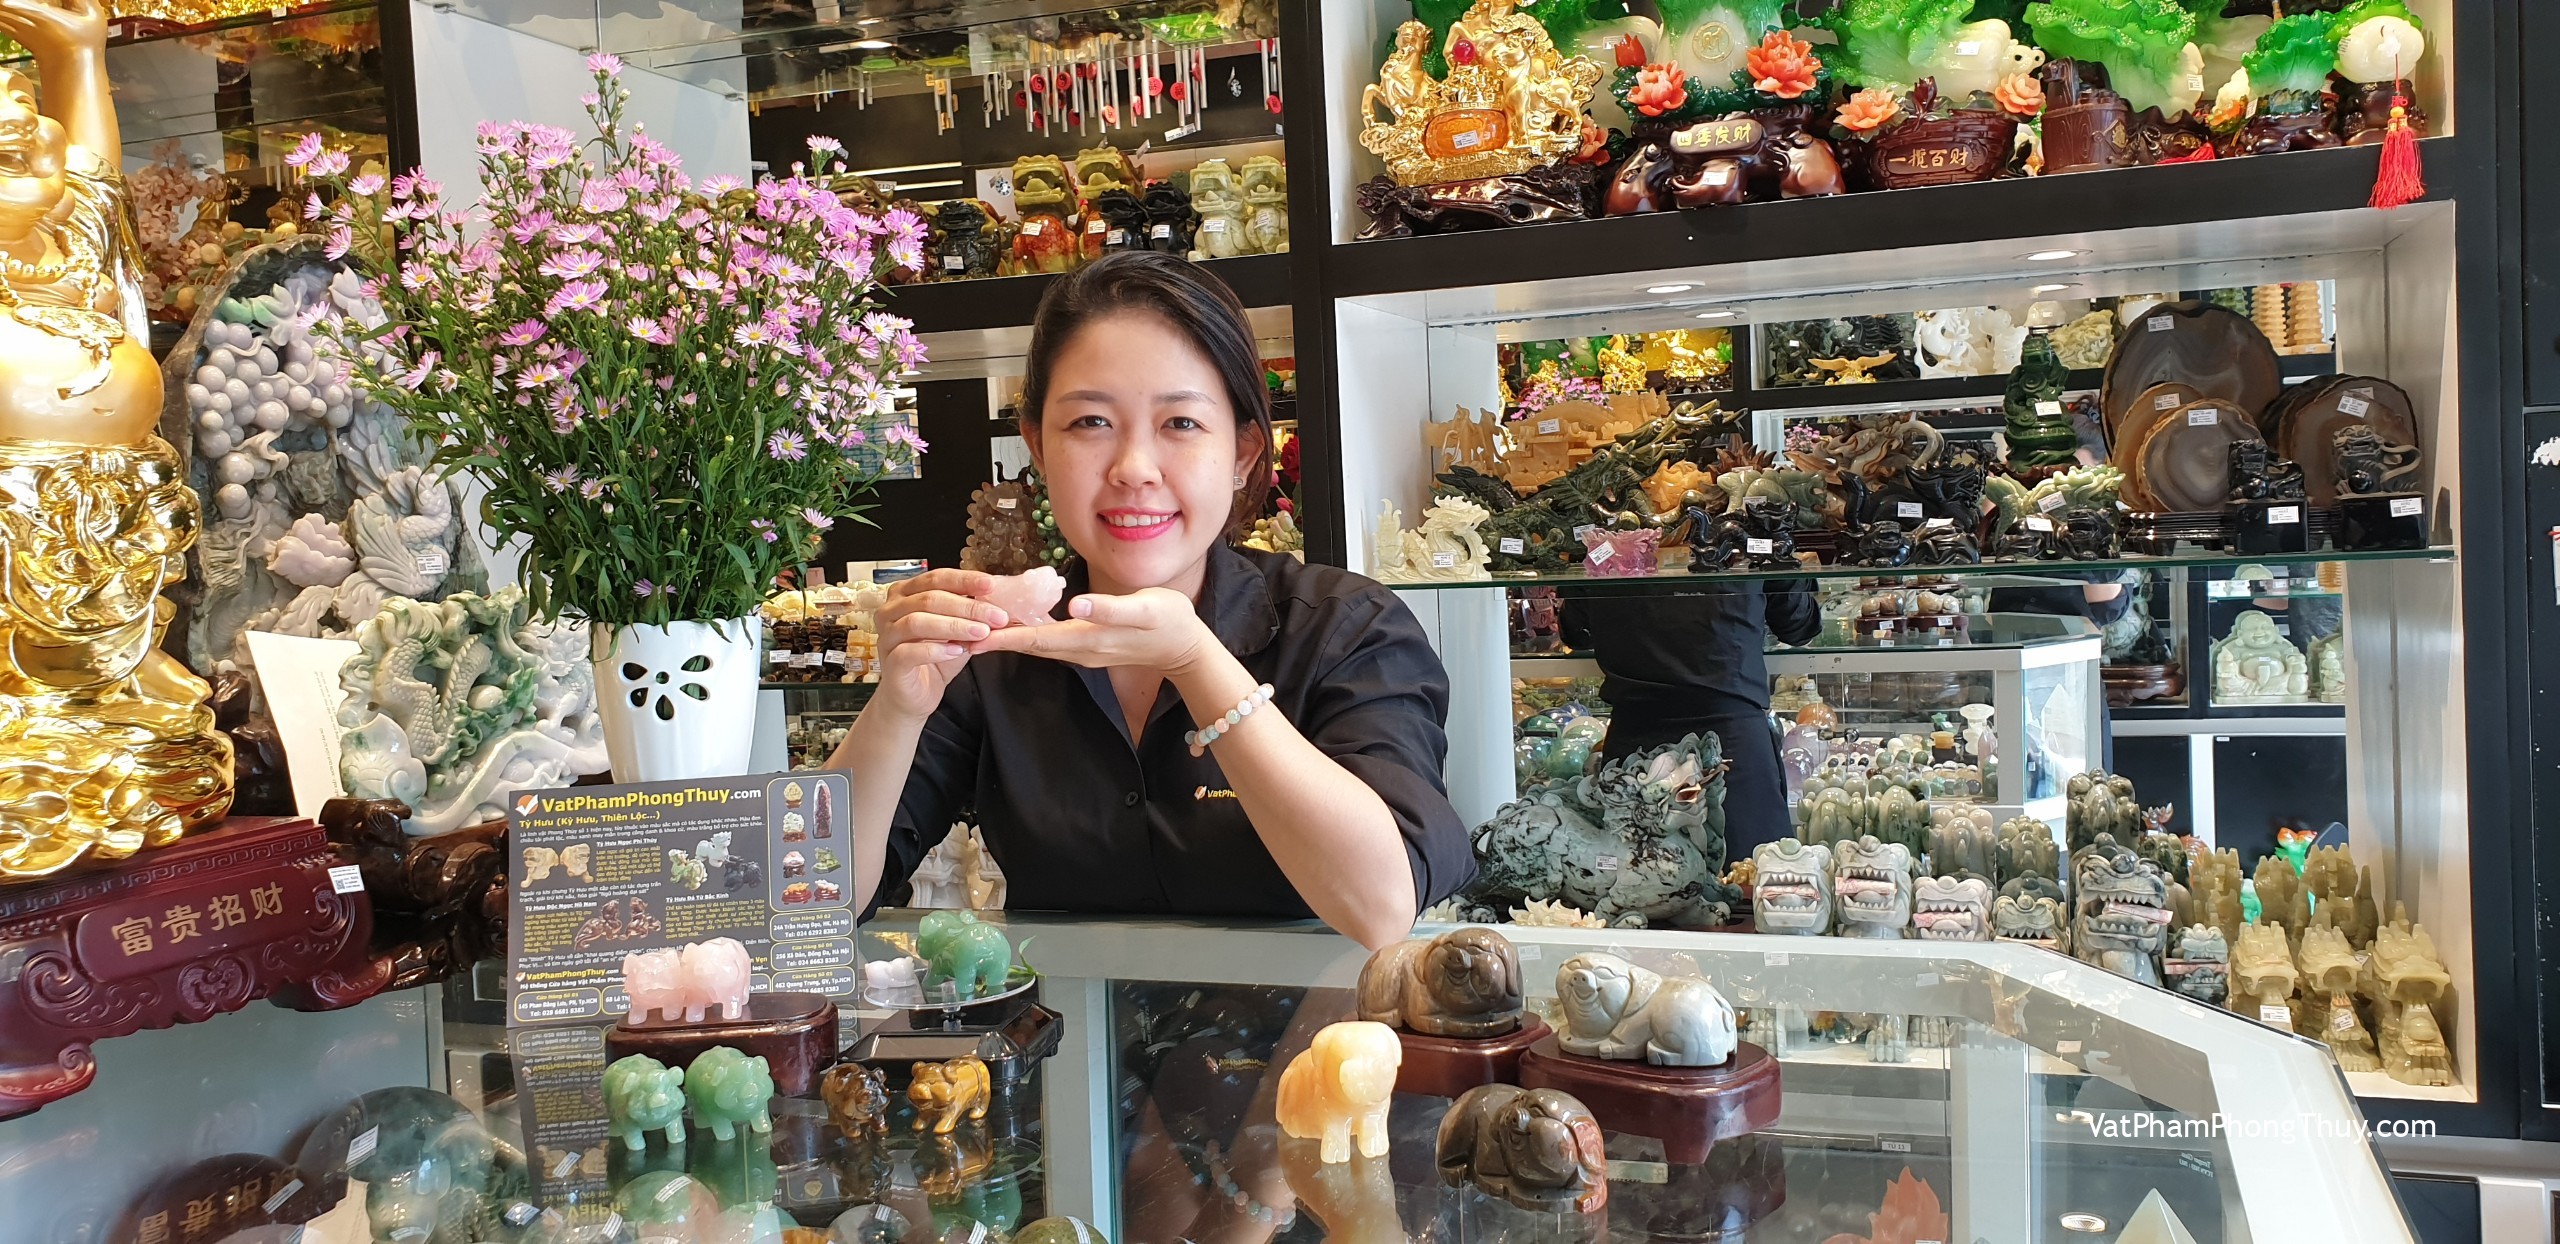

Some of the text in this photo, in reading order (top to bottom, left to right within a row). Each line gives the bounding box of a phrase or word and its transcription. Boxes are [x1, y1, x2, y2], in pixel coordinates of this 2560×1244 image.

[1676, 122, 1752, 148] 四季发财
[1431, 179, 1493, 202] 三羊开
[541, 788, 762, 813] VatPhamPhongThuy.com
[535, 818, 553, 828] Hưu
[577, 815, 598, 825] Hưu,
[602, 813, 627, 823] Thiên
[631, 811, 660, 821] Lộc...)
[110, 881, 285, 957] 富贵招财
[527, 967, 619, 981] VatPhamPhongThuy.com
